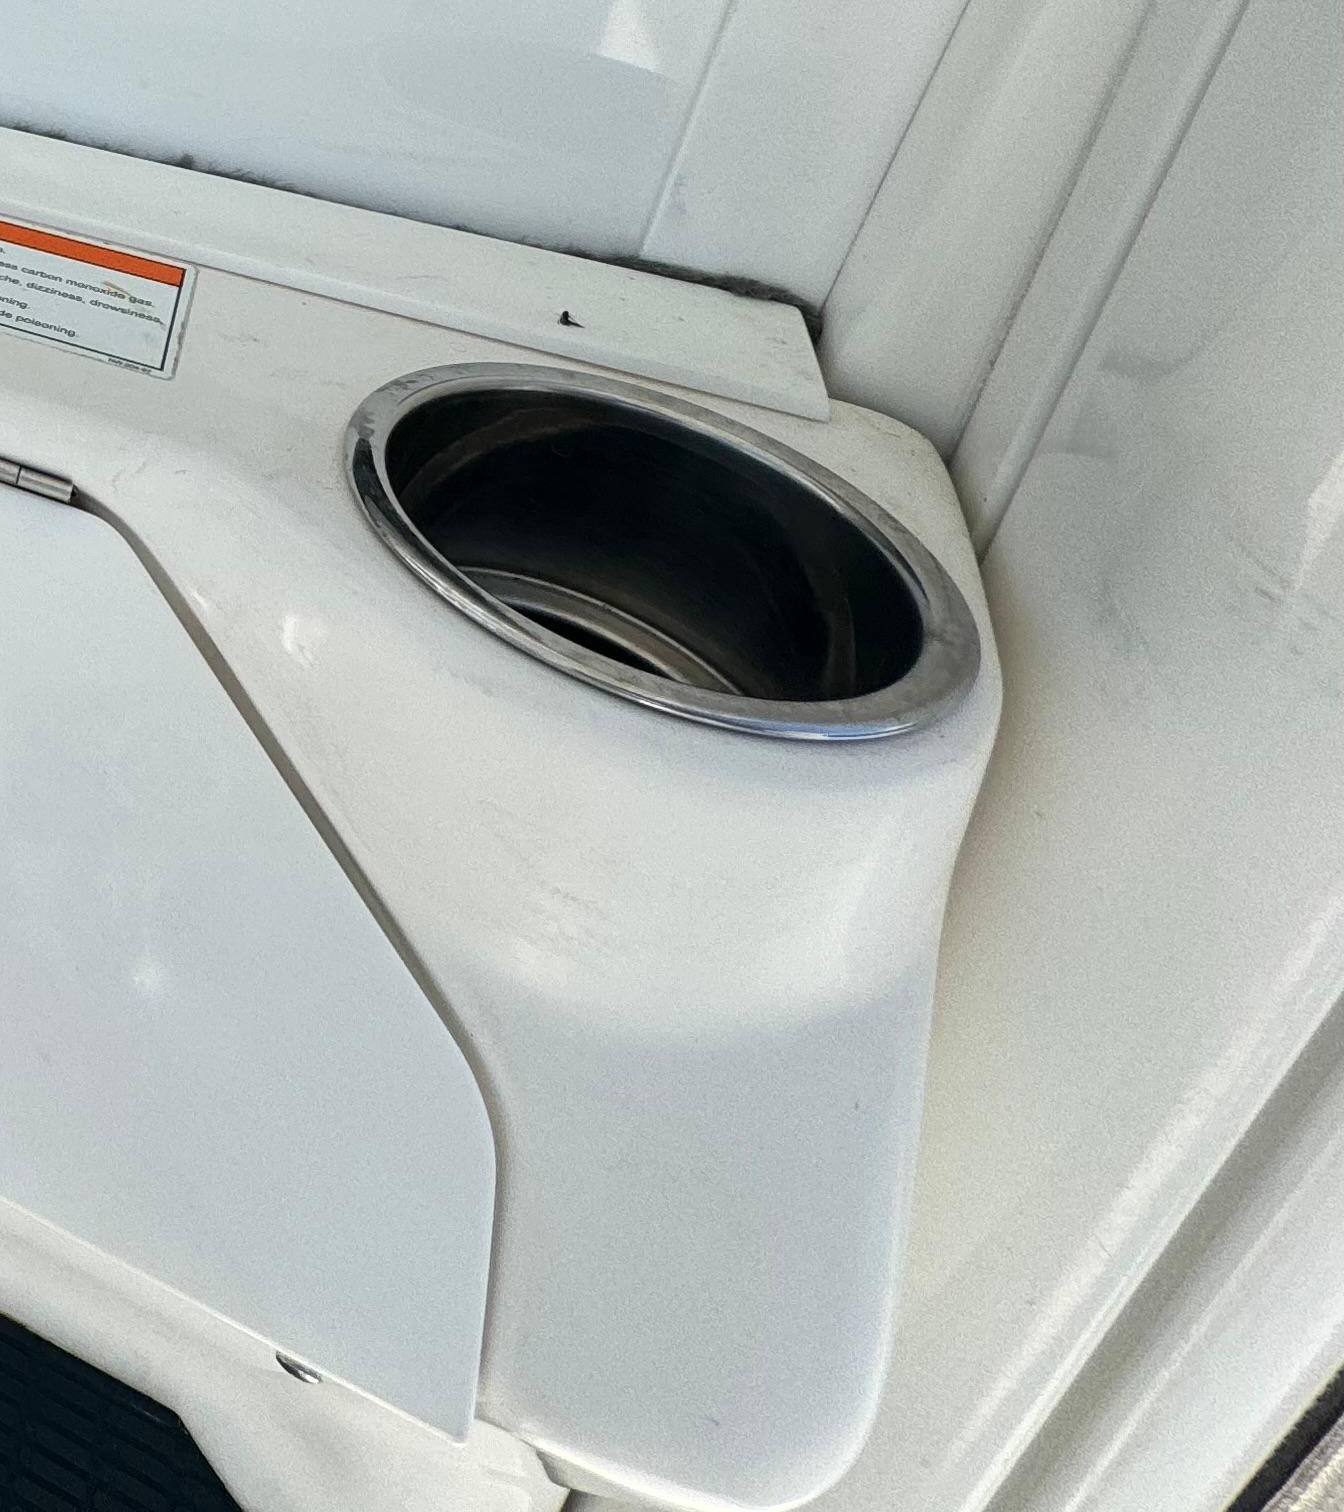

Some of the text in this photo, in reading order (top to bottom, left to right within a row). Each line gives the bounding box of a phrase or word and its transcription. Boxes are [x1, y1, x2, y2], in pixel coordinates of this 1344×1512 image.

[21, 266, 62, 282] carbon
[65, 277, 125, 300] monoxide
[128, 295, 154, 309] gas.
[25, 280, 86, 304] dizziness,
